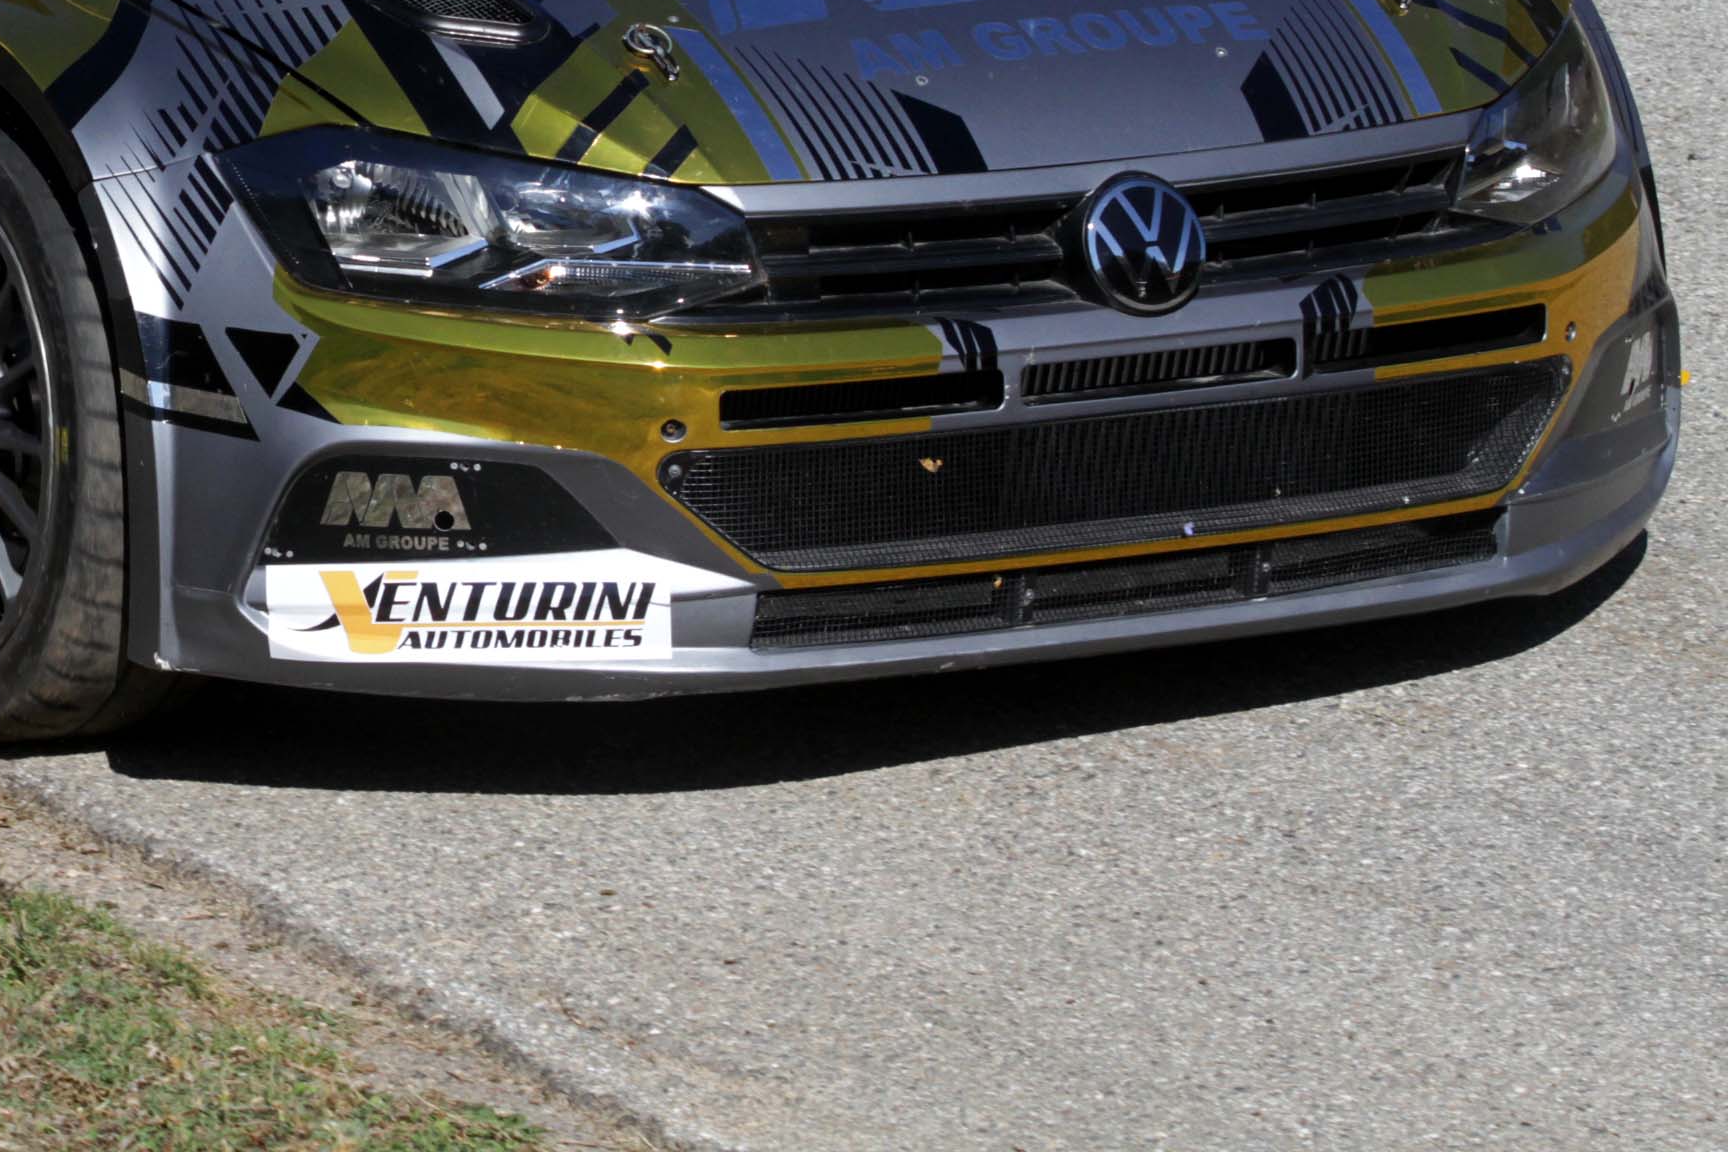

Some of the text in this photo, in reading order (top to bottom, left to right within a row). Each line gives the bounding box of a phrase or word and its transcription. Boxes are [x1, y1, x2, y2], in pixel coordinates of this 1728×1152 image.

[848, 1, 1273, 81] AM GROUPE
[343, 535, 450, 552] AM GROUPE
[396, 627, 644, 650] AUTOMOBILES
